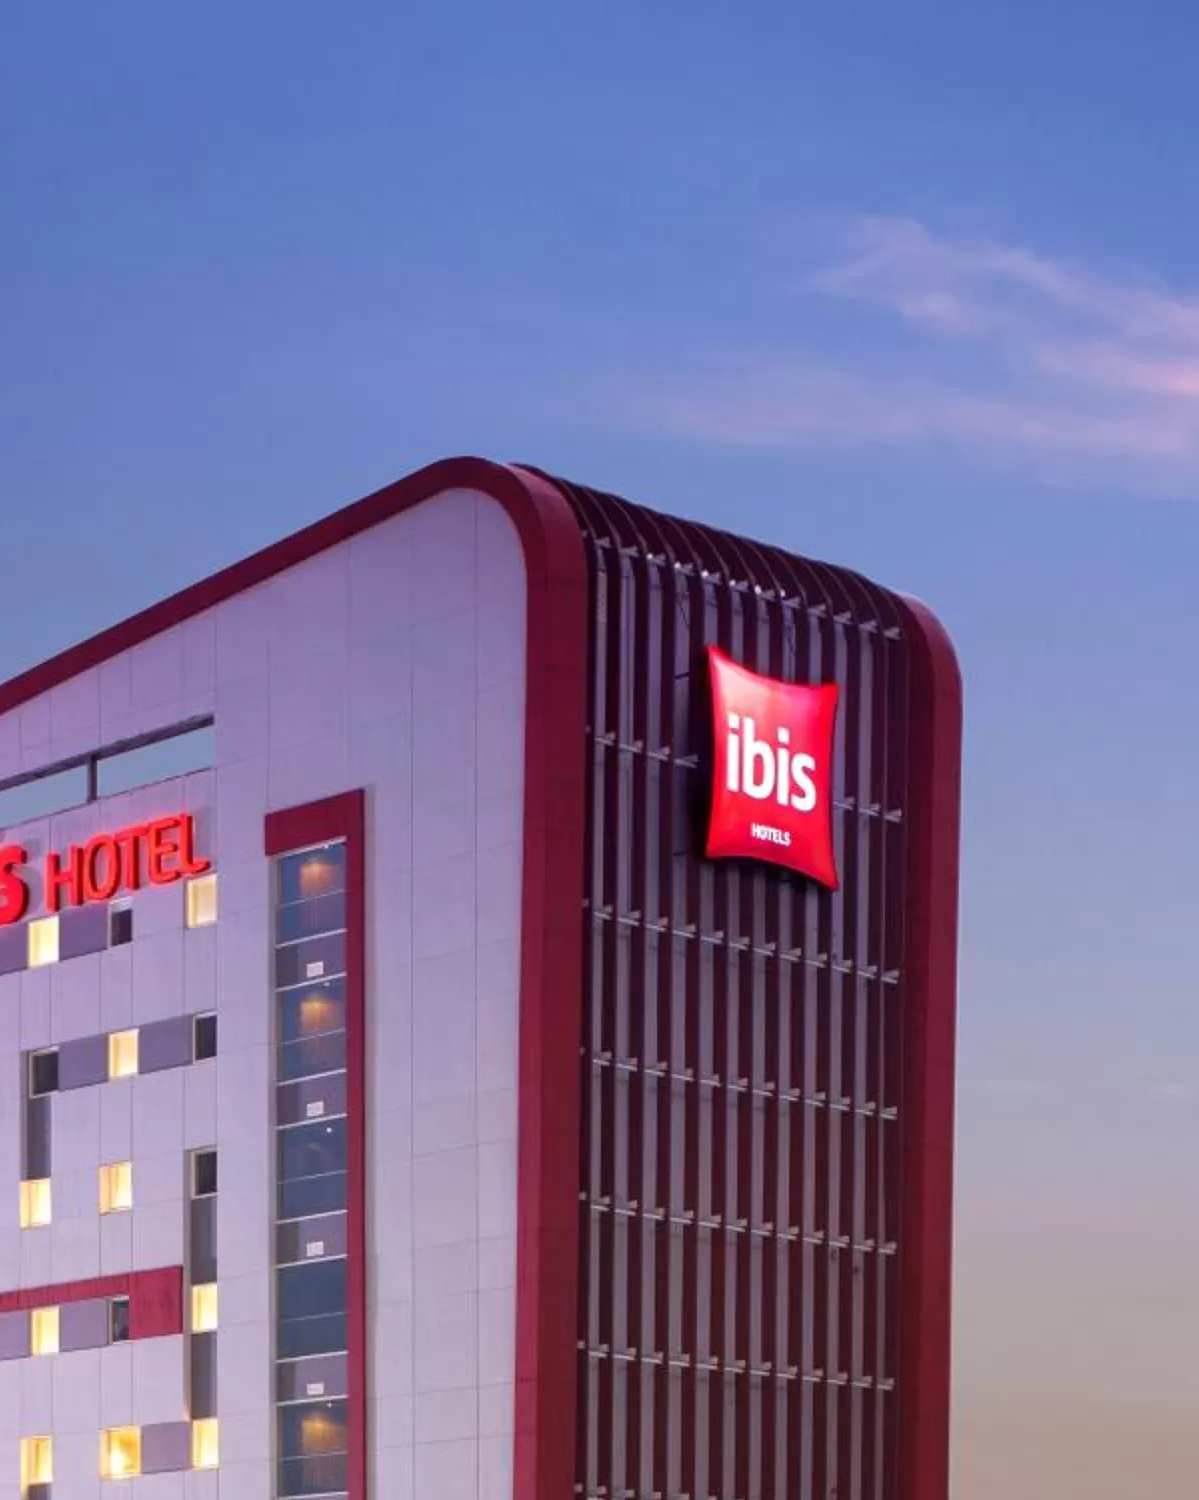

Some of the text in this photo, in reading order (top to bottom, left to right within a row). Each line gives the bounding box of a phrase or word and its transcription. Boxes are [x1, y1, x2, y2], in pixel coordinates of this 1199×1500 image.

[727, 713, 816, 812] ibis
[44, 812, 209, 912] HOTEL
[752, 823, 792, 847] HOTELS
